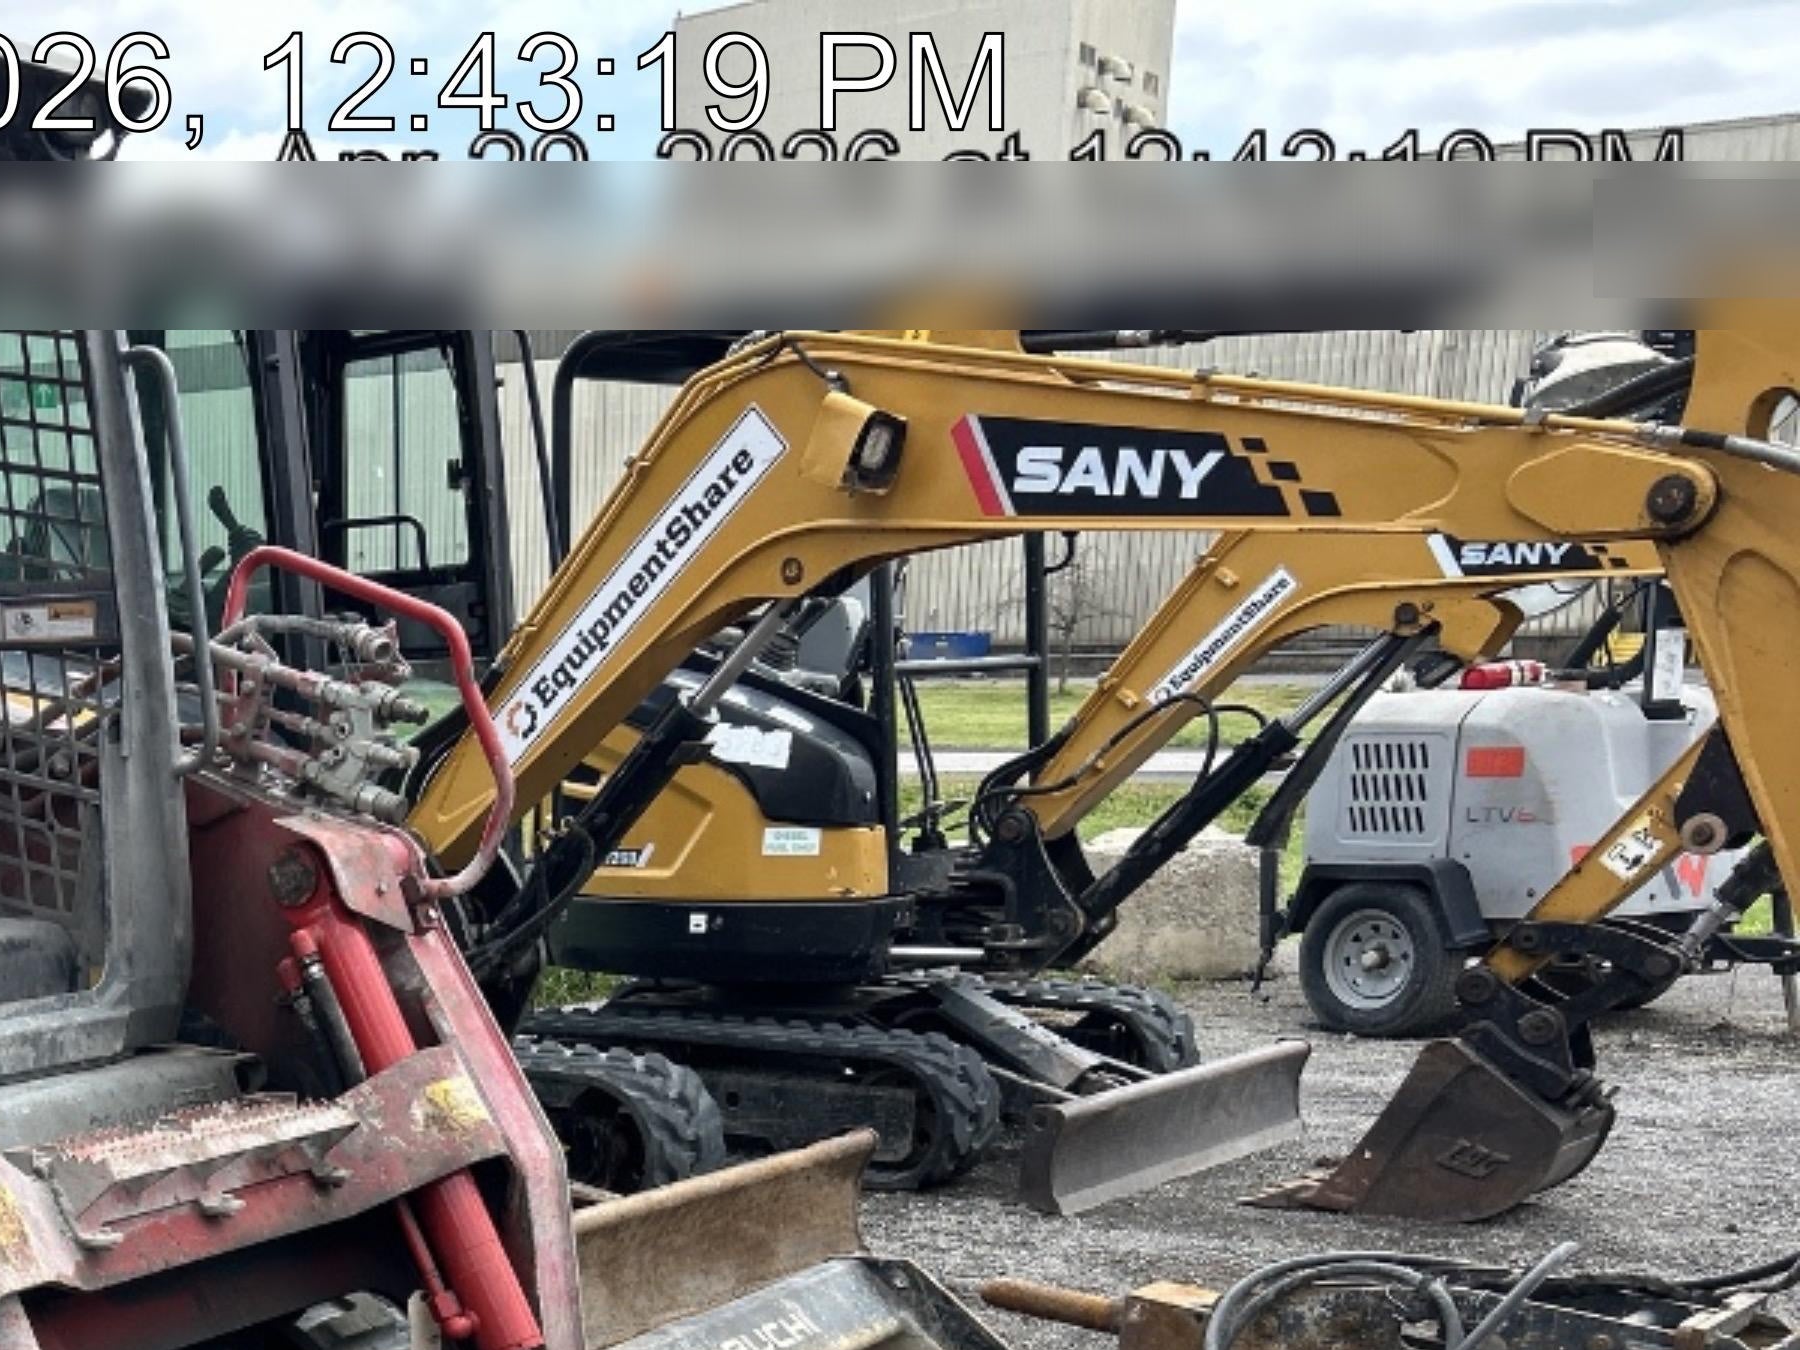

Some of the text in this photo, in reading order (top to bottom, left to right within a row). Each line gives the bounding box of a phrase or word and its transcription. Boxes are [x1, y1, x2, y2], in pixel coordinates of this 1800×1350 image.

[1013, 446, 1226, 500] SANY
[532, 445, 755, 709] EquipmentShare
[1460, 542, 1571, 566] SANY
[1170, 576, 1291, 691] EquipmentShare
